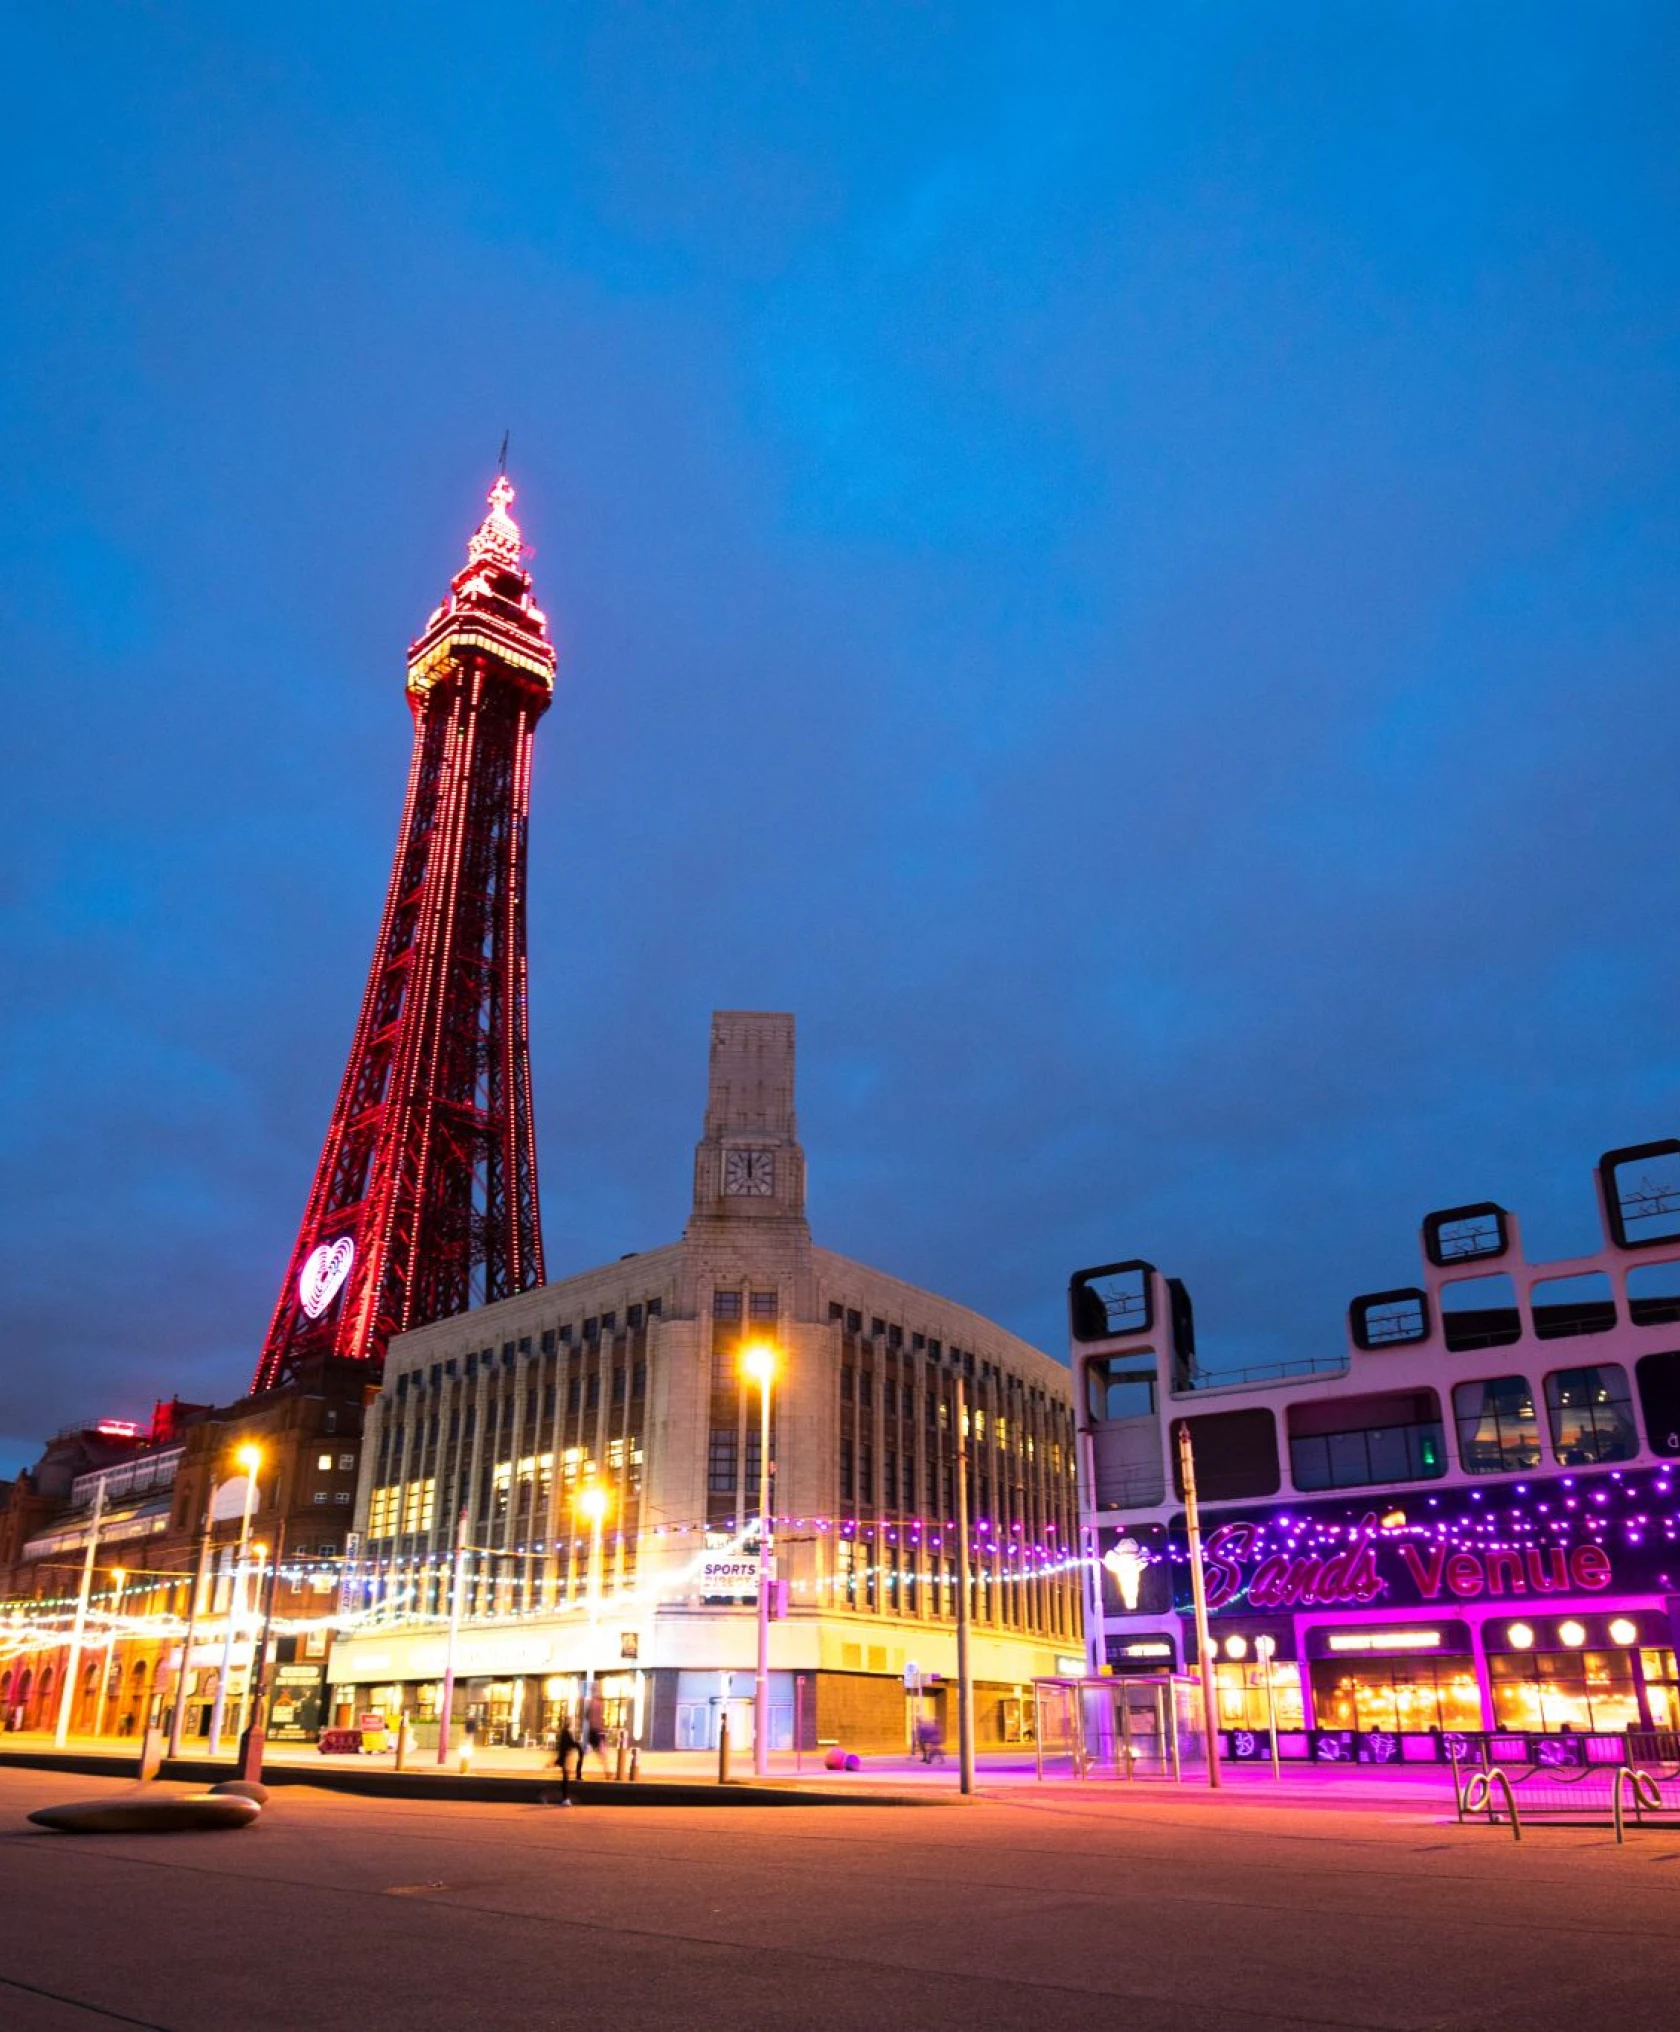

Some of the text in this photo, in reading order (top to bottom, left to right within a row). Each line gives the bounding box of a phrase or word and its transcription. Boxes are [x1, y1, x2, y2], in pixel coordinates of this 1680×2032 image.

[704, 1564, 756, 1575] SPORTS
[1202, 1512, 1612, 1608] Sands Venue
